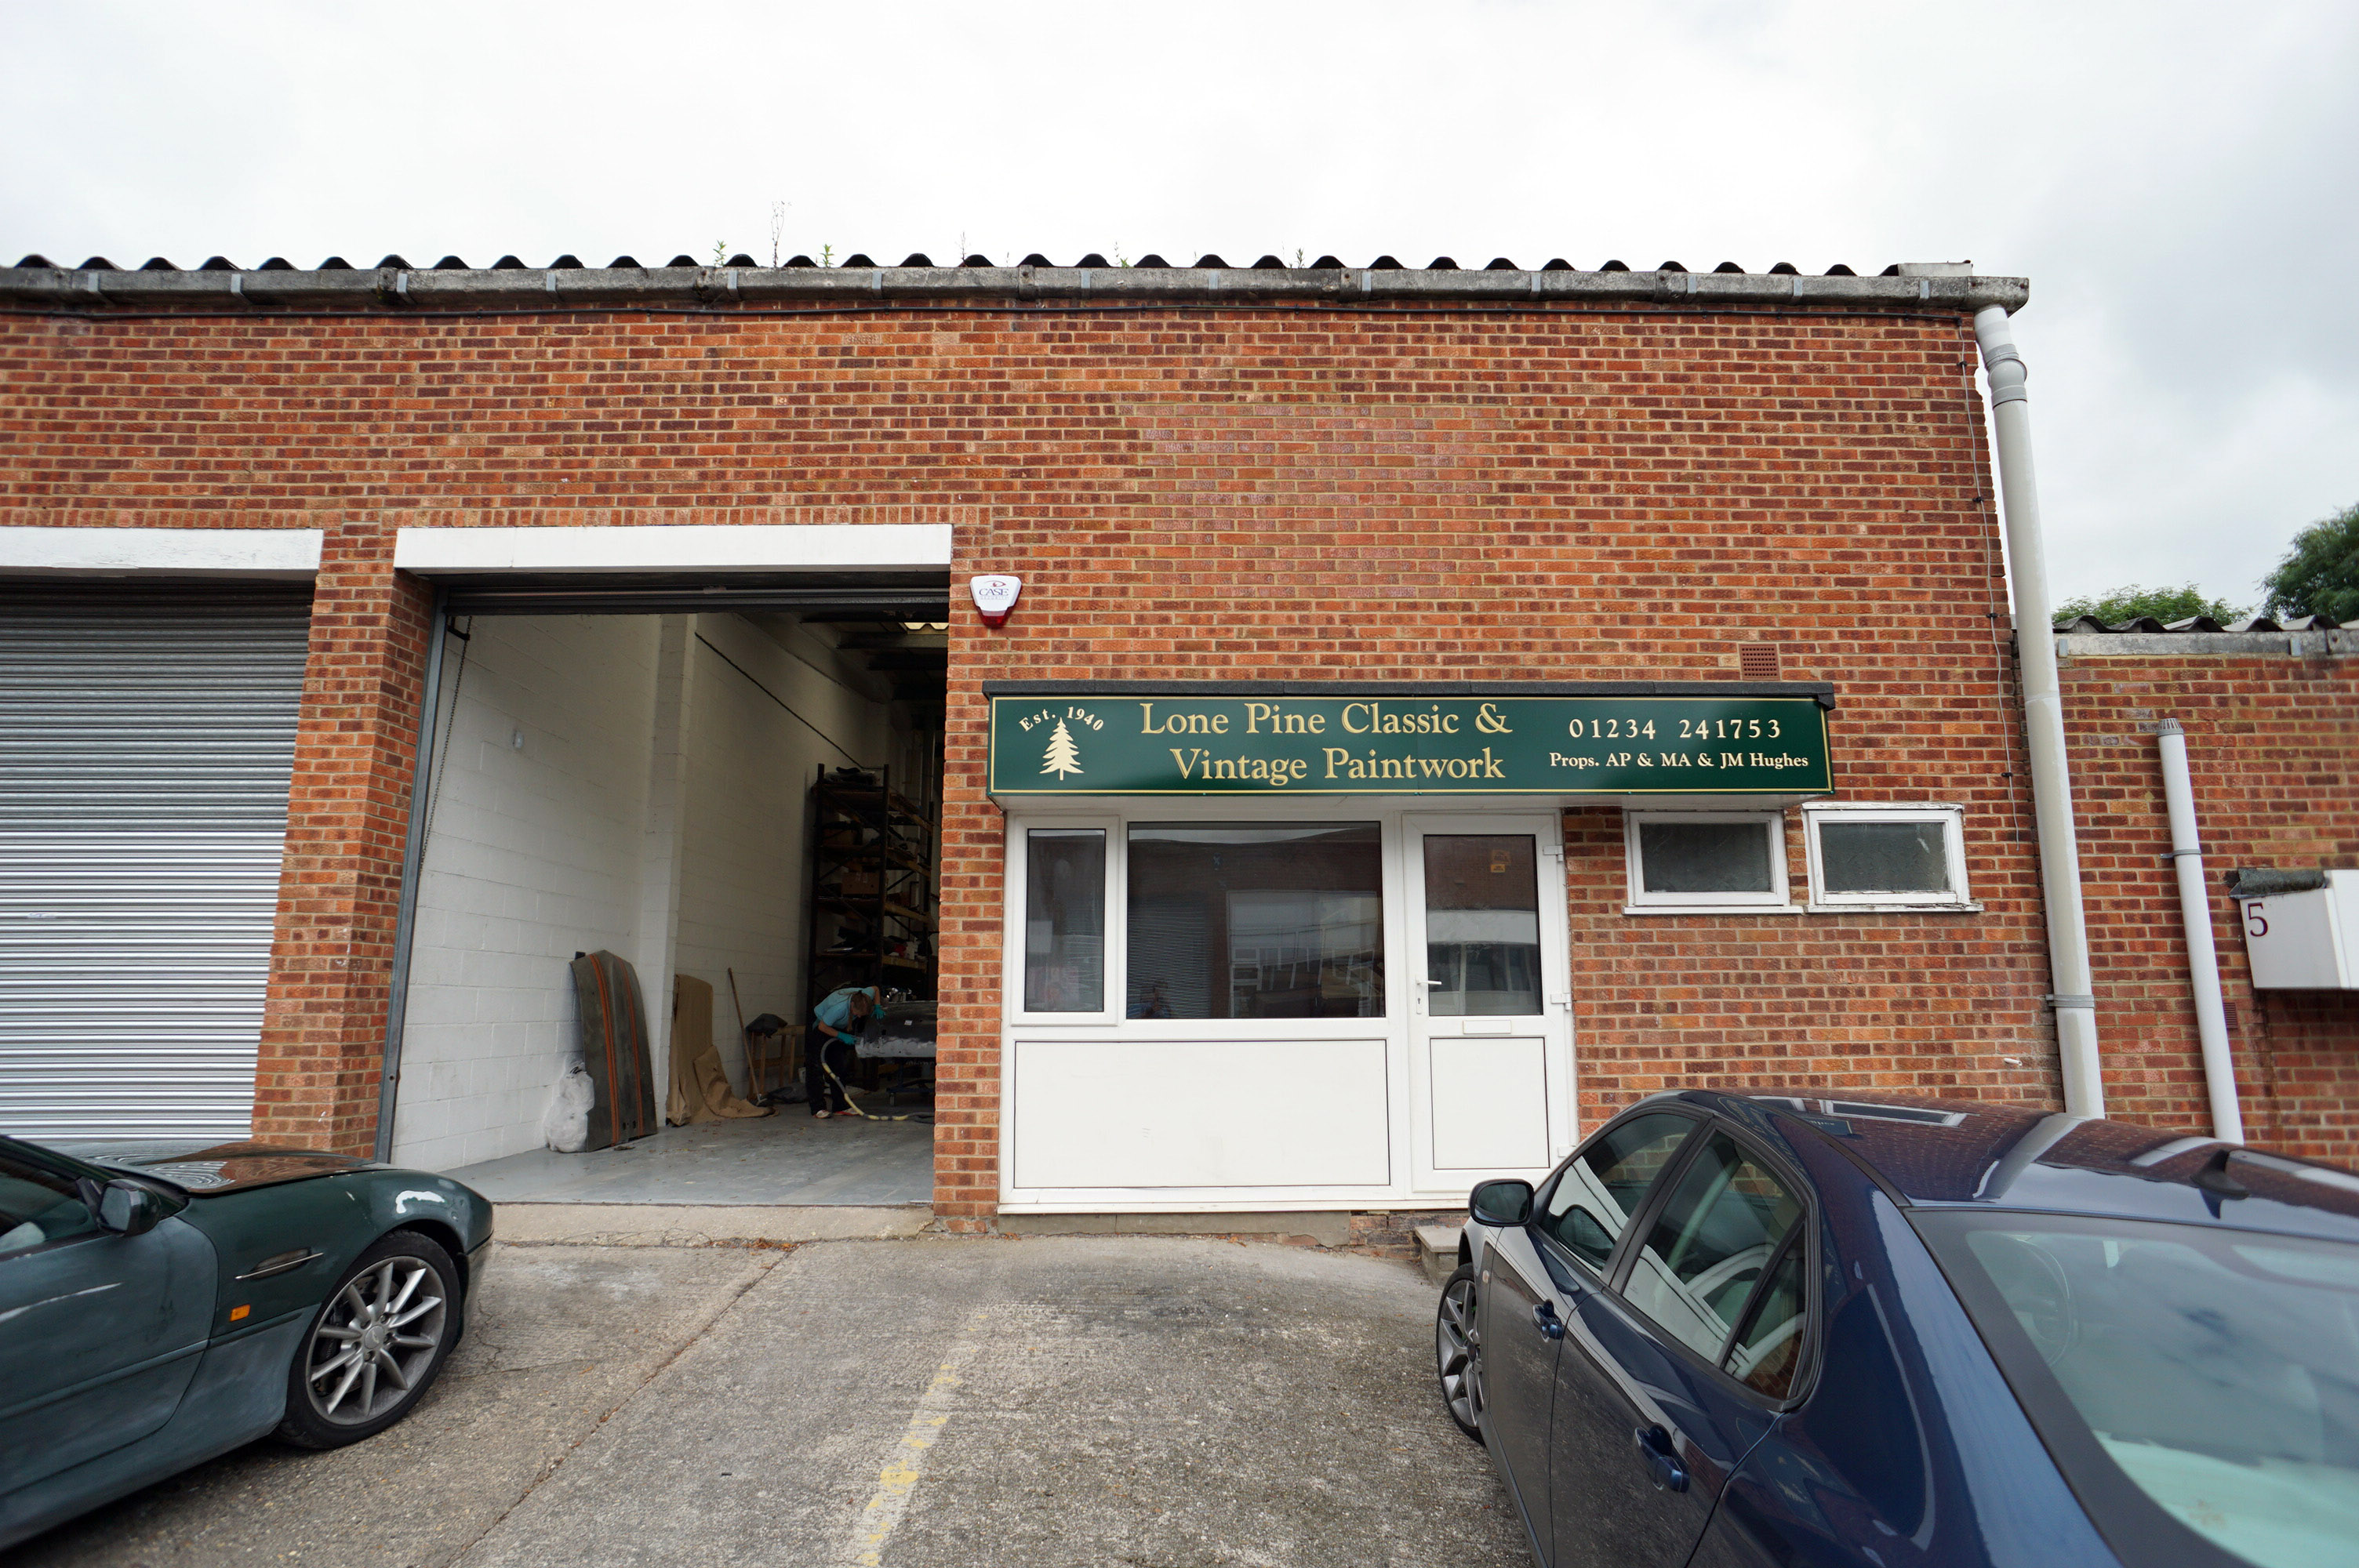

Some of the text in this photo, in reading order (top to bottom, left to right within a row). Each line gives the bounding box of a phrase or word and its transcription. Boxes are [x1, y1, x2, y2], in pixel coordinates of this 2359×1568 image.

[1019, 706, 1104, 731] Est. 1940
[1140, 702, 1514, 734] Lone Pine Classic &
[1568, 718, 1781, 740] 01234 241753
[1169, 746, 1506, 786] Vintage Paintwork
[1549, 752, 1808, 770] Props. AP & MA & JM Hughes
[2248, 902, 2269, 937] 5
